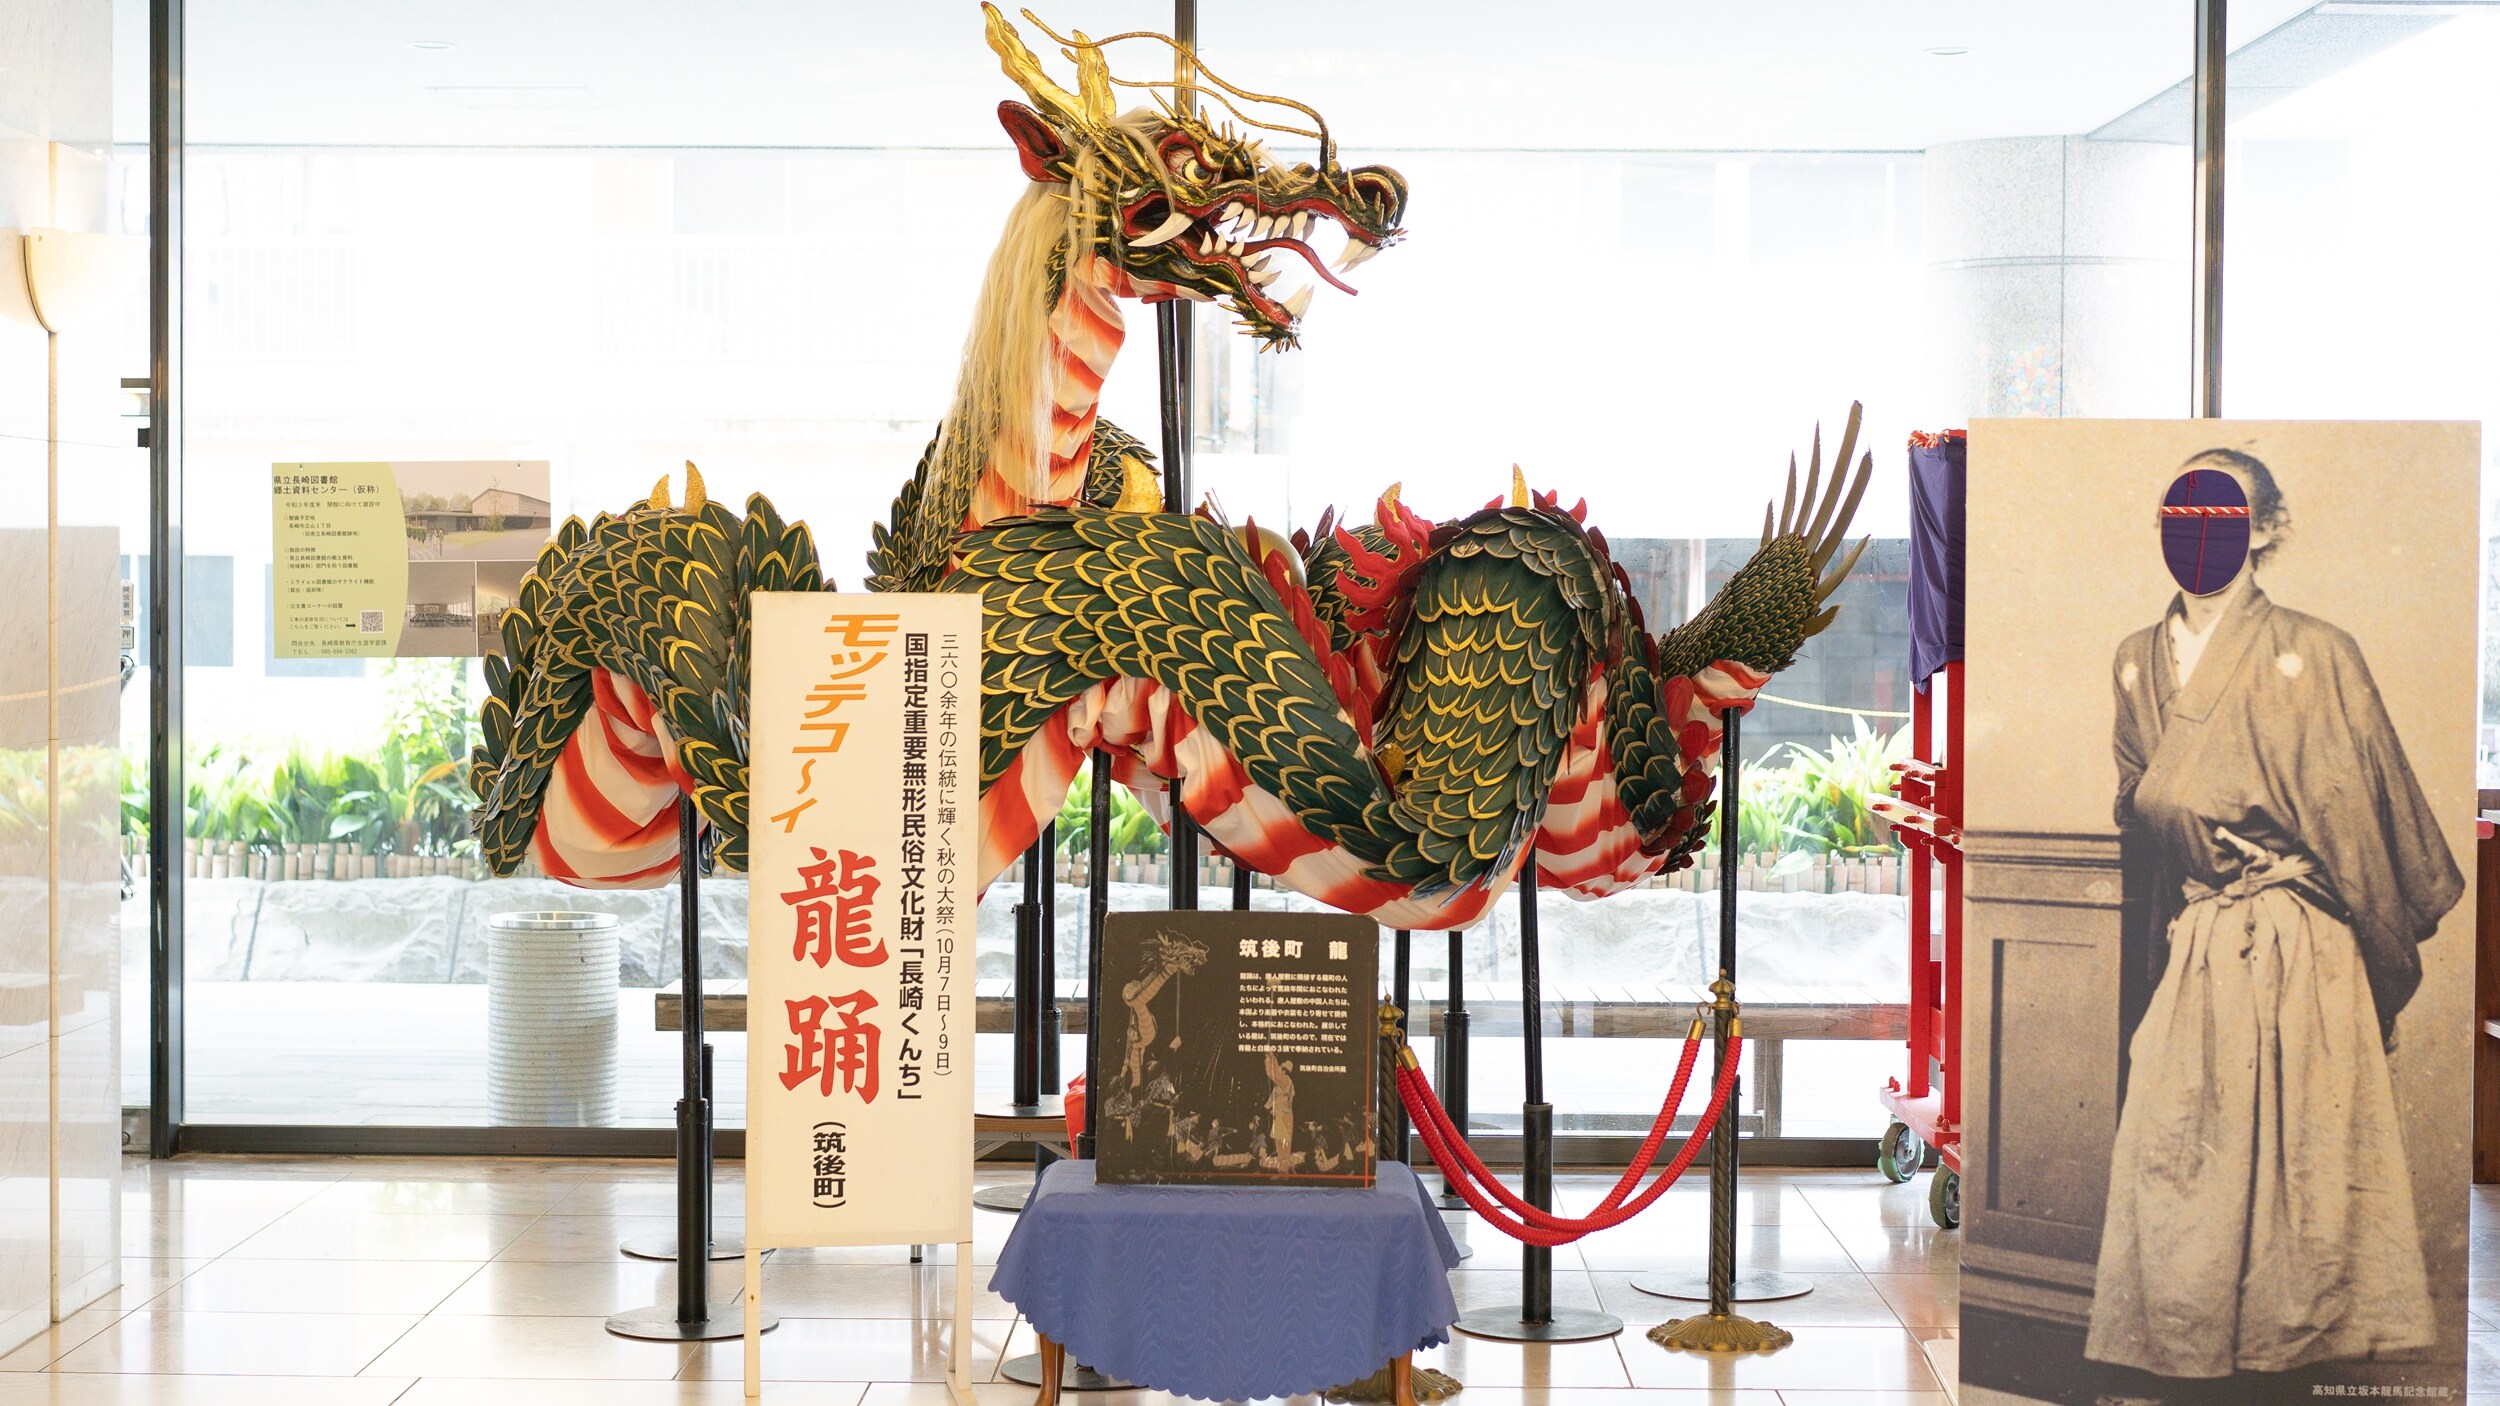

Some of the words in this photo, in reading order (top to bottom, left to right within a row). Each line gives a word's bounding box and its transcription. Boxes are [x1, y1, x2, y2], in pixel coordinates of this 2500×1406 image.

[273, 475, 338, 485] 県立長崎図書館
[273, 485, 381, 495] 郷土資料センター（仮称）
[897, 632, 929, 1100] 国指定重要無形民俗文化財「長崎くんち」
[1238, 938, 1304, 959] 筑後町
[1328, 940, 1348, 960] 龍
[778, 846, 890, 1105] 龍踊
[812, 1121, 847, 1209] （筑後町）
[2312, 1384, 2449, 1398] 高知県立坂本龍馬記念館蔵
